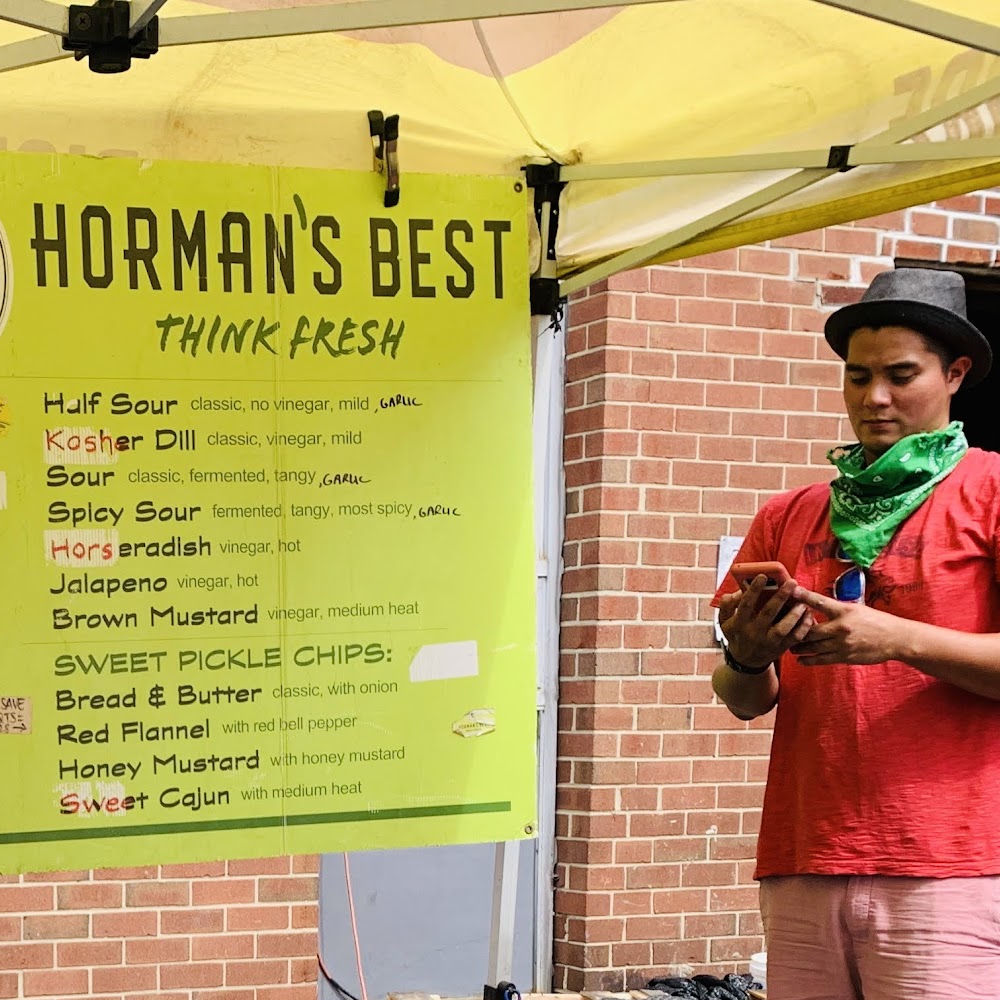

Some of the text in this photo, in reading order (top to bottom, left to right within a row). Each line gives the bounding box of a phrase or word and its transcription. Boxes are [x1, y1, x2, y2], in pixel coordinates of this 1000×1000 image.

[30, 195, 512, 299] HORMAN'S BEST
[155, 311, 405, 360] THINK FRESH
[44, 391, 370, 415] Half Sour classic, no vinegar, mild
[45, 429, 363, 456] Kosher Dill classic, vinegar, mild
[46, 465, 317, 487] Sour classic, fermented, tangy
[48, 501, 124, 528] Spicy
[135, 500, 202, 522] Sour
[212, 503, 286, 519] fermented,
[291, 503, 334, 520] tangy,
[338, 503, 373, 516] most
[51, 535, 301, 561] Horseradish vinegar, hot
[50, 573, 259, 598] Jalapeno vinegar, hot
[53, 601, 419, 629] Brown Mustard vinegar, medium heat
[54, 643, 392, 676] SWEET PICKLE CHIPS:
[56, 680, 398, 711] Bread & Butter classic, with onion
[57, 717, 358, 745] Red Flannel with red bell pepper
[59, 746, 405, 780] Honey Mustard with honey mustard
[60, 781, 362, 815] Sweet Cajun with medium heat
